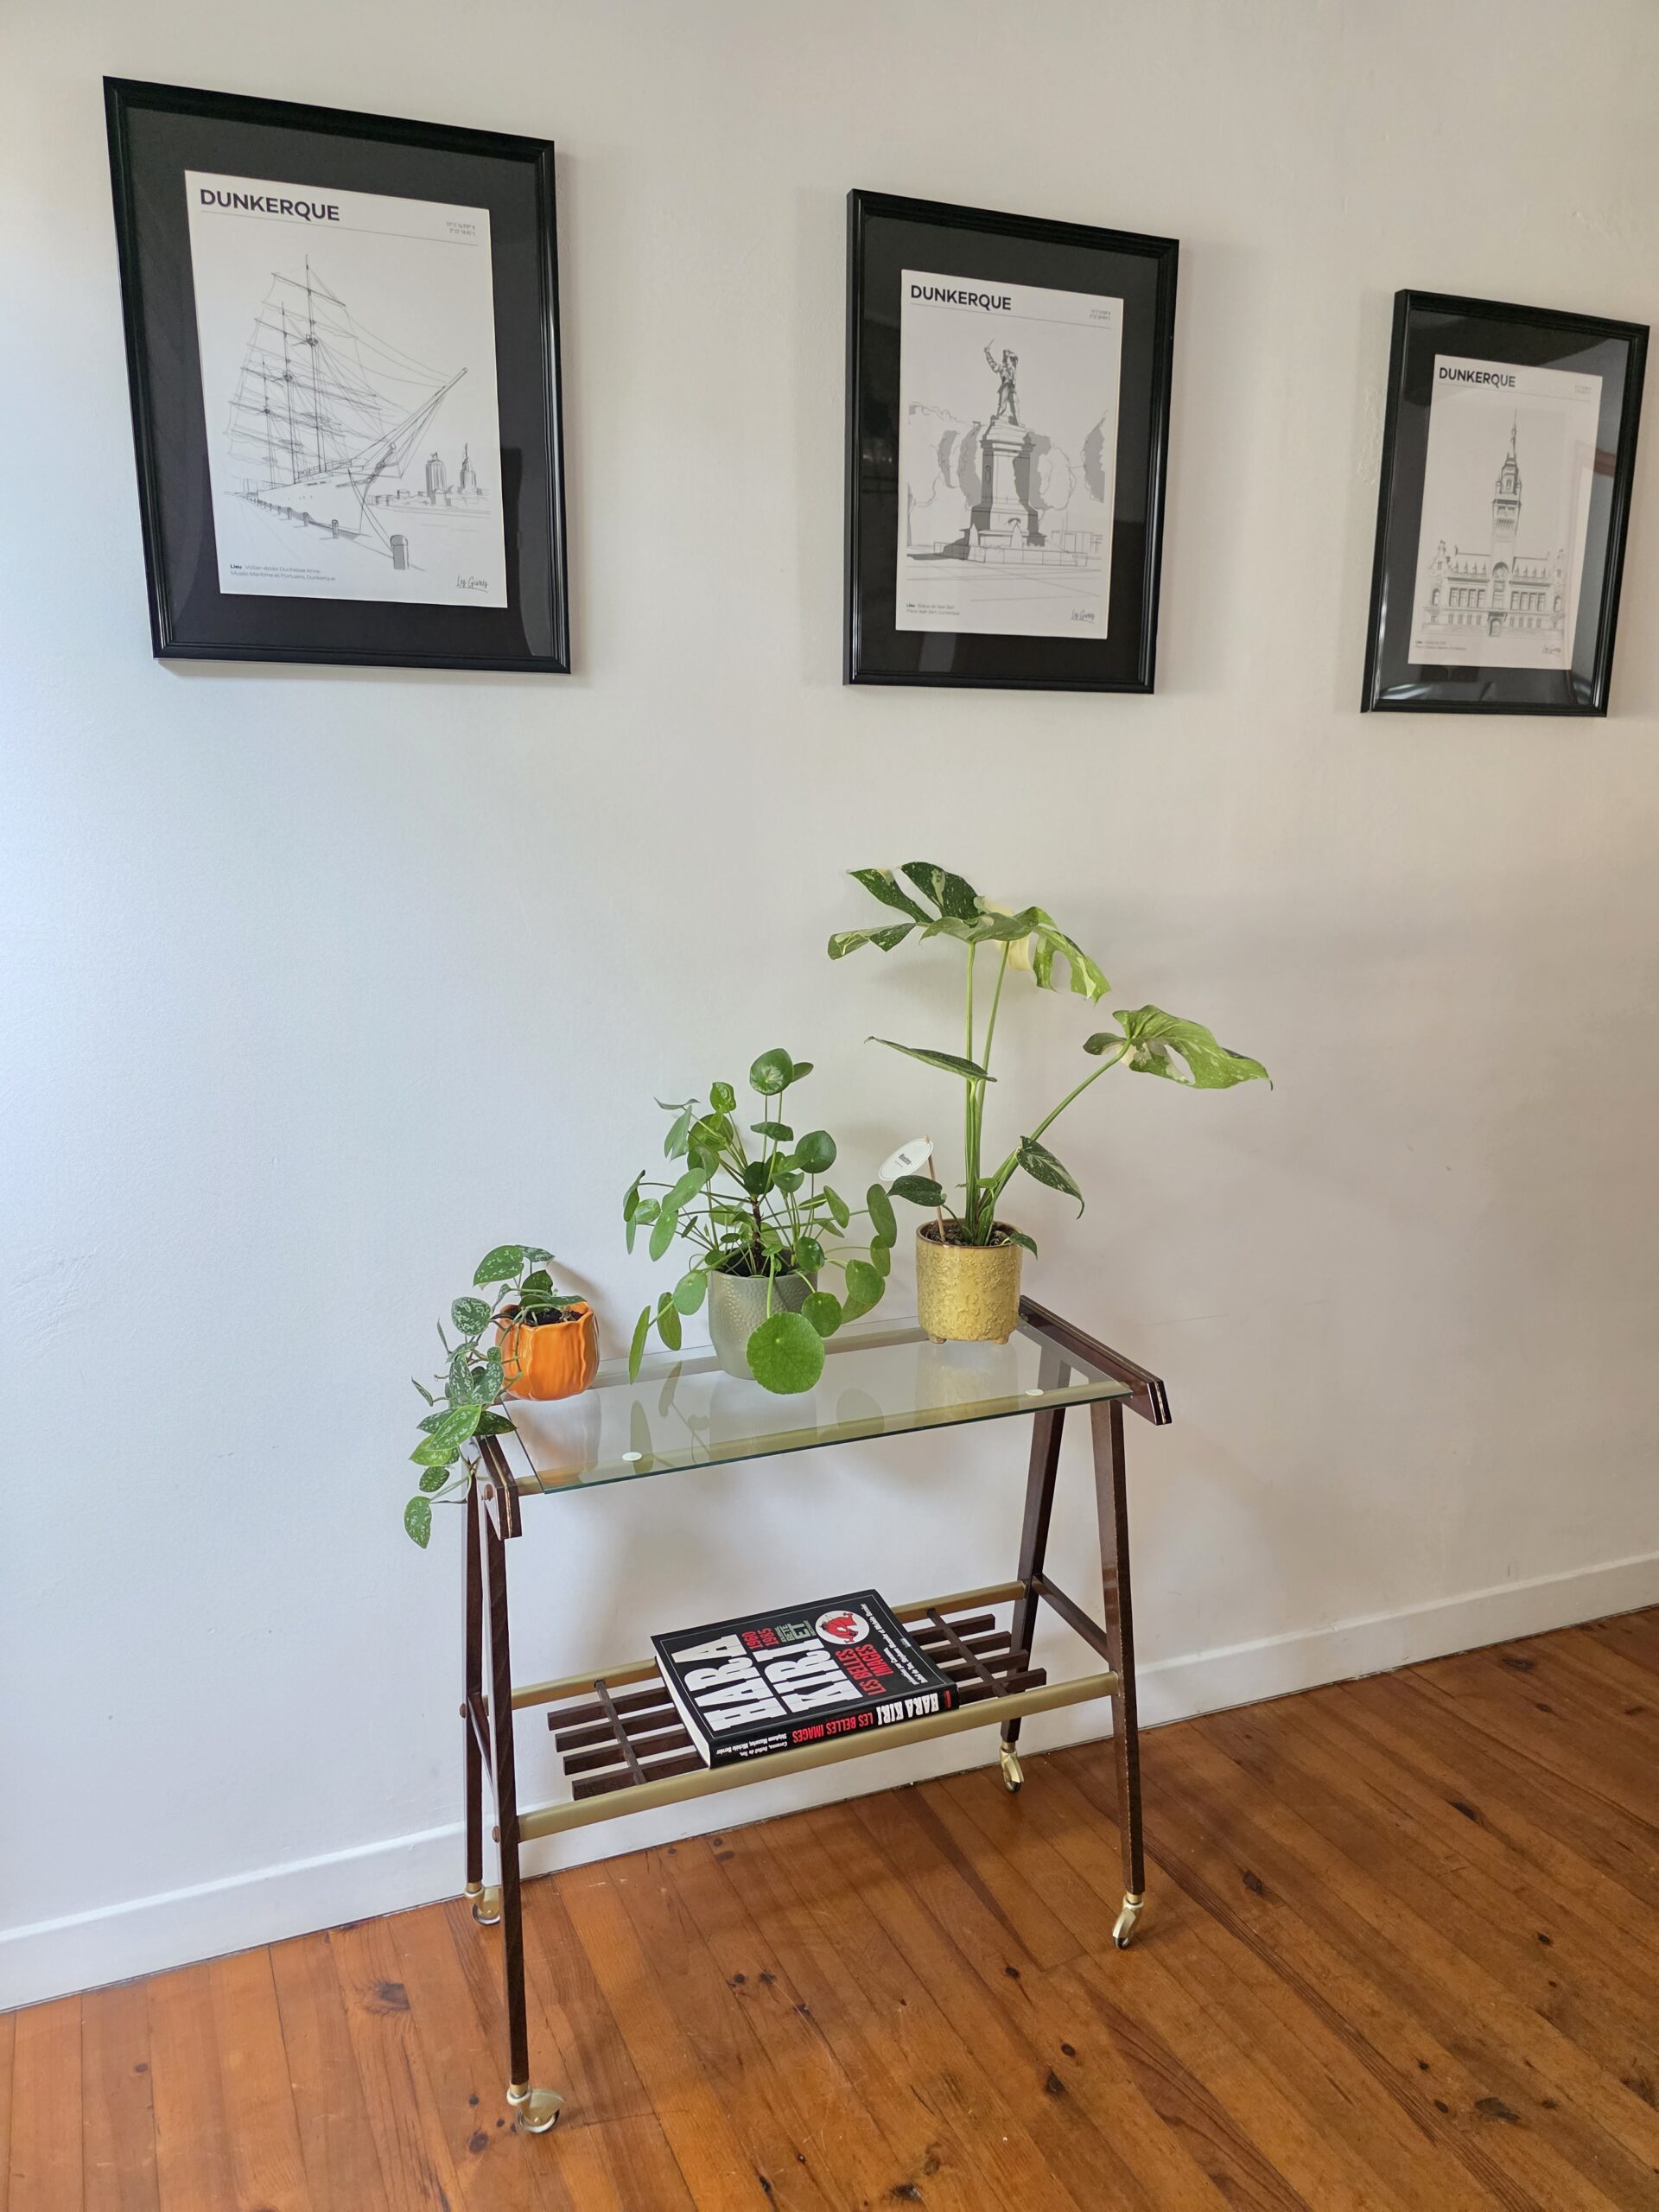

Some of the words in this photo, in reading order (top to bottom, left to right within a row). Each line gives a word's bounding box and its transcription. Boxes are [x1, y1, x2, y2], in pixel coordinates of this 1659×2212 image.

[200, 188, 340, 222] DUNKERQUE
[911, 284, 1012, 311] DUNKERQUE
[1439, 367, 1516, 389] DUNKERQUE
[741, 1630, 764, 1649] 1960
[757, 1627, 779, 1647] 1985
[787, 1623, 811, 1640] ET
[835, 1647, 874, 1681] BELLES
[855, 1643, 894, 1677] IMAGES
[671, 1633, 788, 1732] HARA
[753, 1637, 863, 1713] KIRI
[859, 1678, 887, 1696] LES
[875, 1700, 904, 1726] KIRI
[904, 1692, 940, 1719] HARA
[826, 1713, 857, 1736] BELLES
[858, 1712, 874, 1726] LES
[791, 1723, 825, 1744] IMAGES
